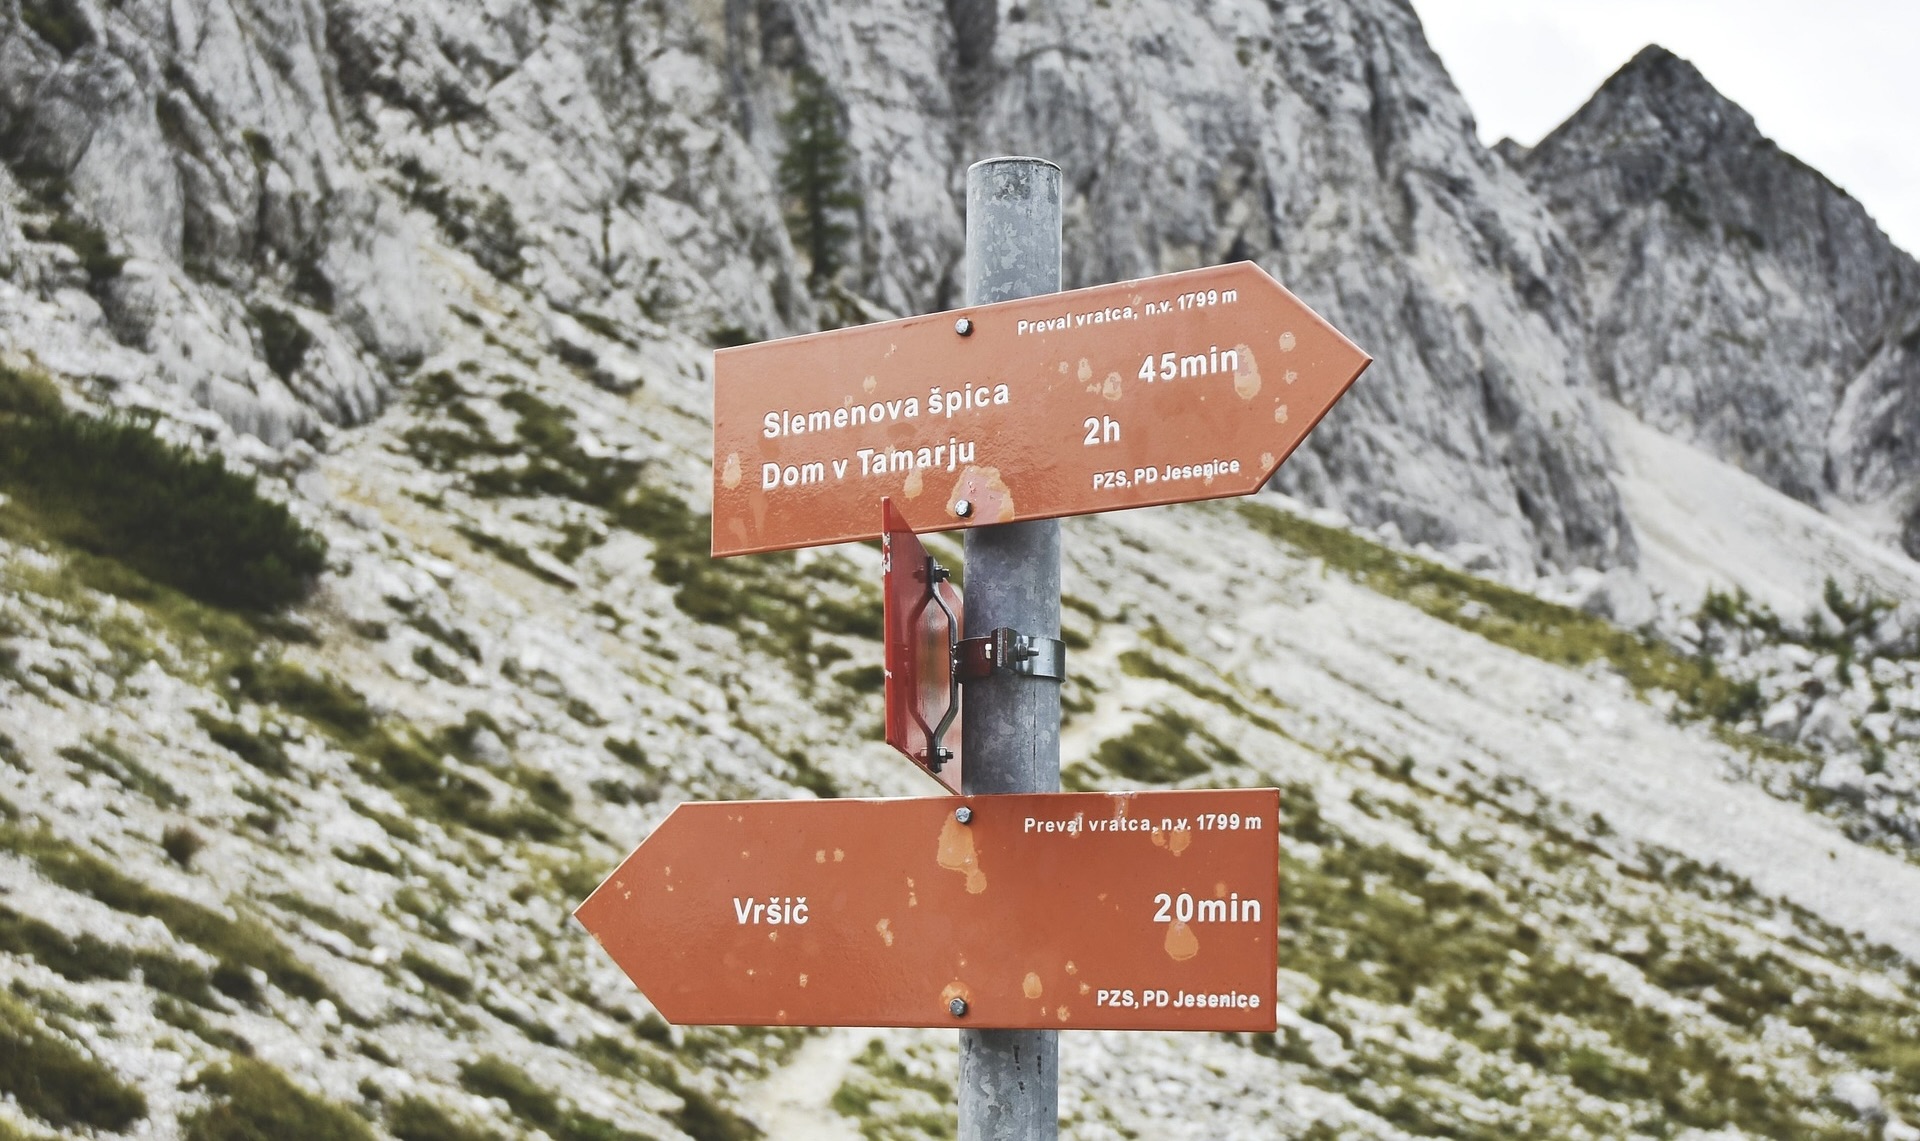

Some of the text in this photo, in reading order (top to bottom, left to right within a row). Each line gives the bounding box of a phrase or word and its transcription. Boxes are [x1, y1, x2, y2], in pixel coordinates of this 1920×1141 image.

[1017, 288, 1238, 335] Preval vratca, n.v. 1799 m
[1138, 345, 1239, 383] 45min
[763, 382, 1010, 439] Slemenova špica
[1083, 416, 1121, 446] 2h
[762, 437, 975, 491] Dom v Tamarju
[1093, 459, 1240, 490] PZS, PD Jesenice
[1024, 814, 1262, 833] Preval vratca, n.v. 1799 m
[733, 896, 809, 925] Vršič
[1153, 893, 1261, 923] 20min
[1097, 990, 1260, 1009] PZS, PD Jesenice
